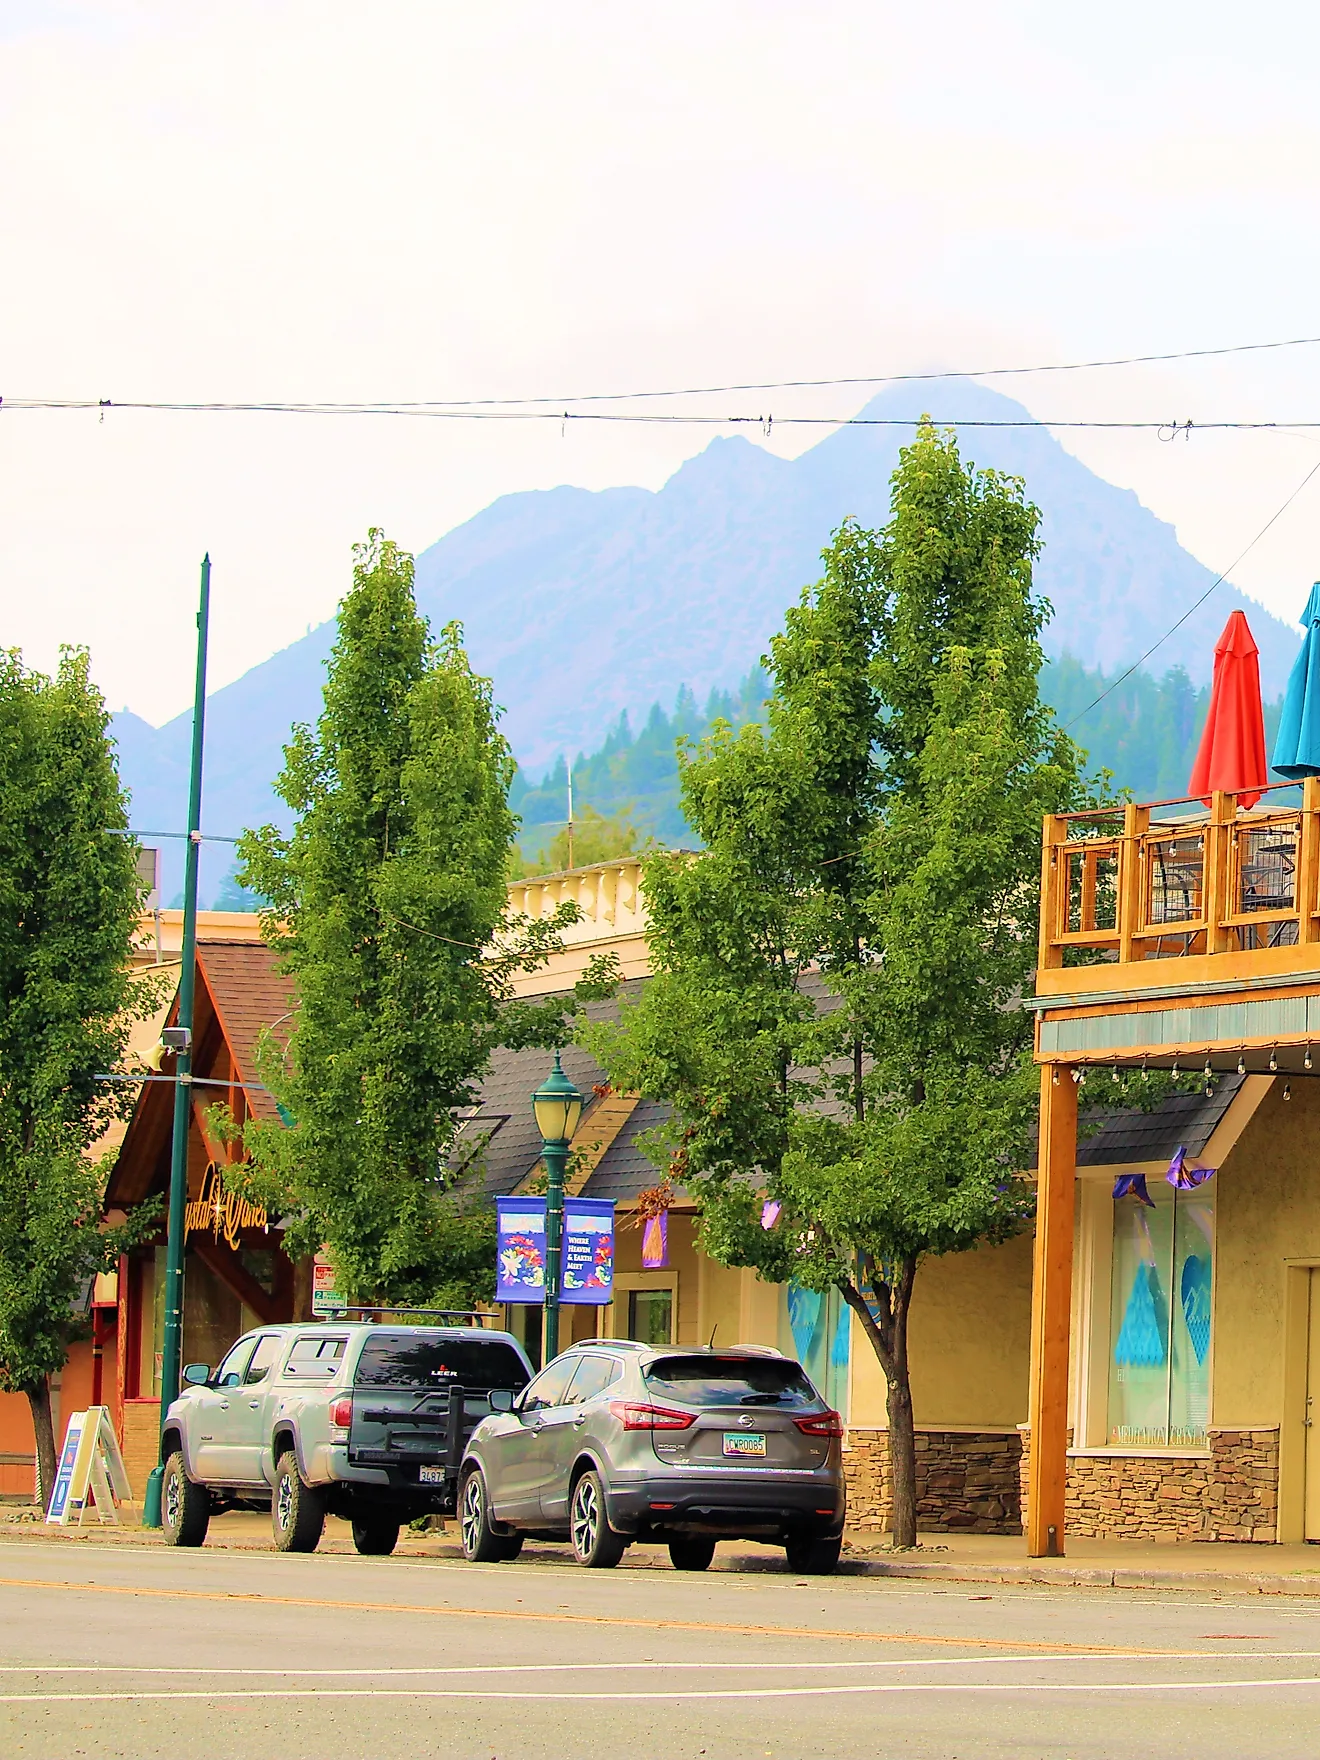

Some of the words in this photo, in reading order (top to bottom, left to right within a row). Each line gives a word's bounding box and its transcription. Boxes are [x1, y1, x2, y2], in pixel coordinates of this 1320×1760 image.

[568, 1237, 589, 1245] WHERE
[568, 1245, 590, 1253] HEAVEN
[574, 1254, 592, 1262] EARTH
[316, 1291, 322, 1299] 2
[421, 1471, 446, 1482] 34873
